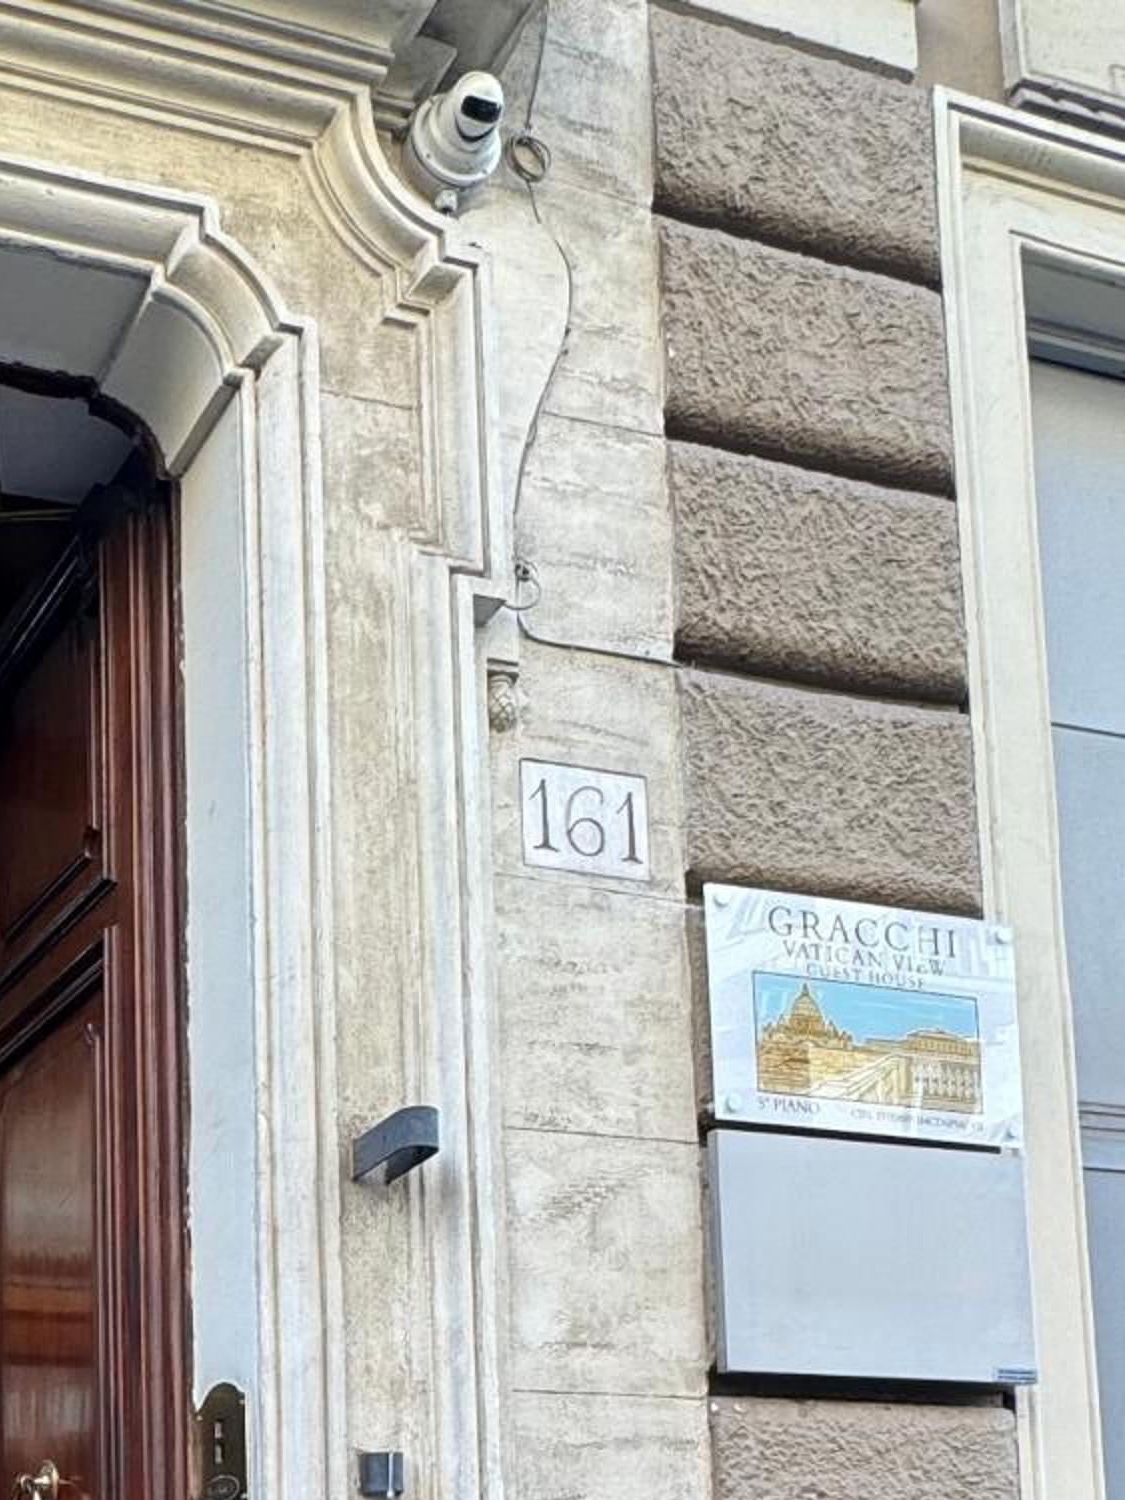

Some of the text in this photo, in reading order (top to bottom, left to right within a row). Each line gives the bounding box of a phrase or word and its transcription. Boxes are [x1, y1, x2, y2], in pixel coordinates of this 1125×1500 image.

[528, 779, 643, 864] 161
[768, 905, 956, 958] GRACCHI
[783, 940, 882, 968] VATICAN
[806, 963, 924, 990] GUEST HOUSE
[774, 1097, 821, 1115] PIANO
